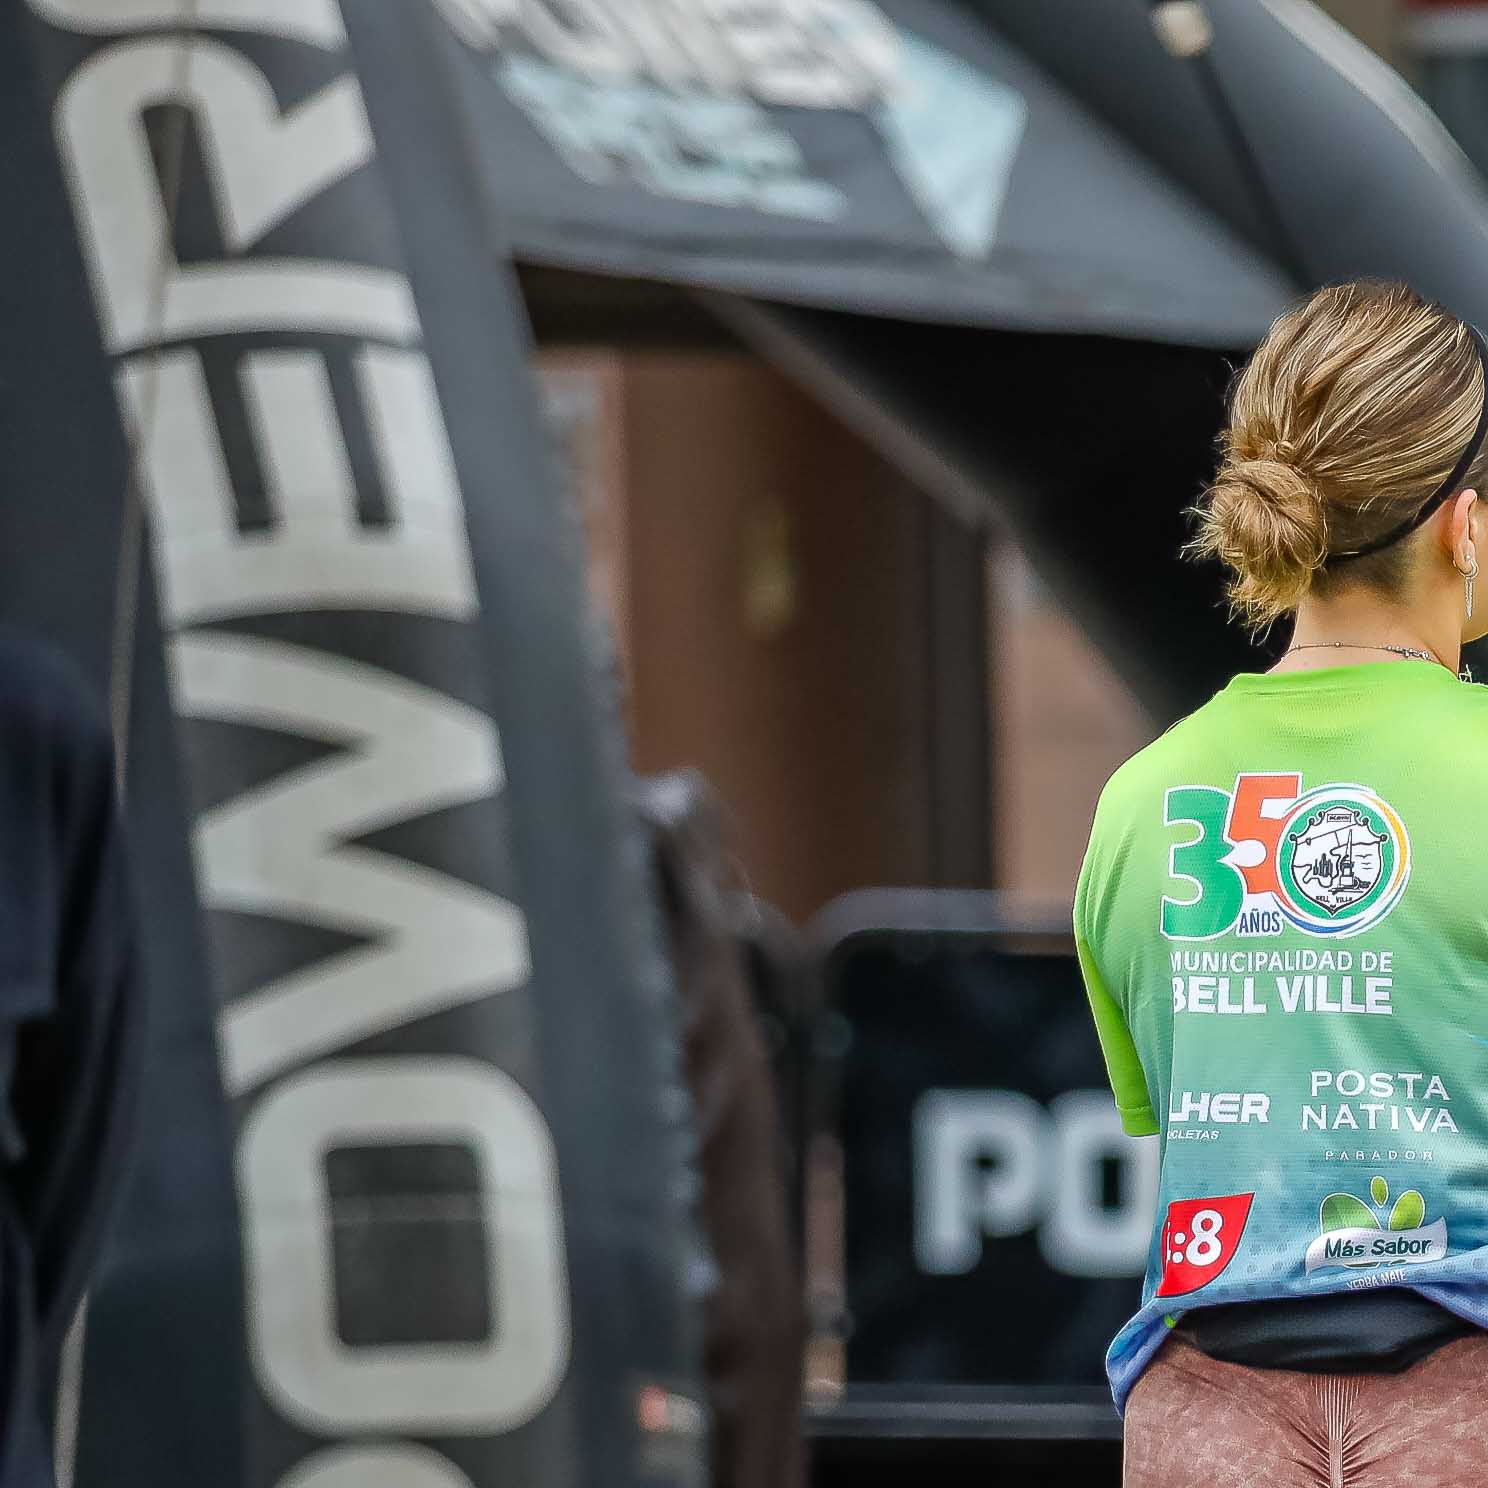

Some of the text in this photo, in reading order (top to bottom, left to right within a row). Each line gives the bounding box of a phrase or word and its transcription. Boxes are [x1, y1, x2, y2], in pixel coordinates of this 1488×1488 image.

[1239, 909, 1281, 934] AÑOS
[1361, 952, 1393, 973] DE
[1276, 974, 1394, 1016] VILLE
[1311, 1069, 1451, 1101] POSTA
[1300, 1103, 1460, 1134] NATIVA
[1325, 1150, 1434, 1161] PARADOR
[1166, 1208, 1225, 1267] :8
[1324, 1235, 1433, 1259] Más Sabor
